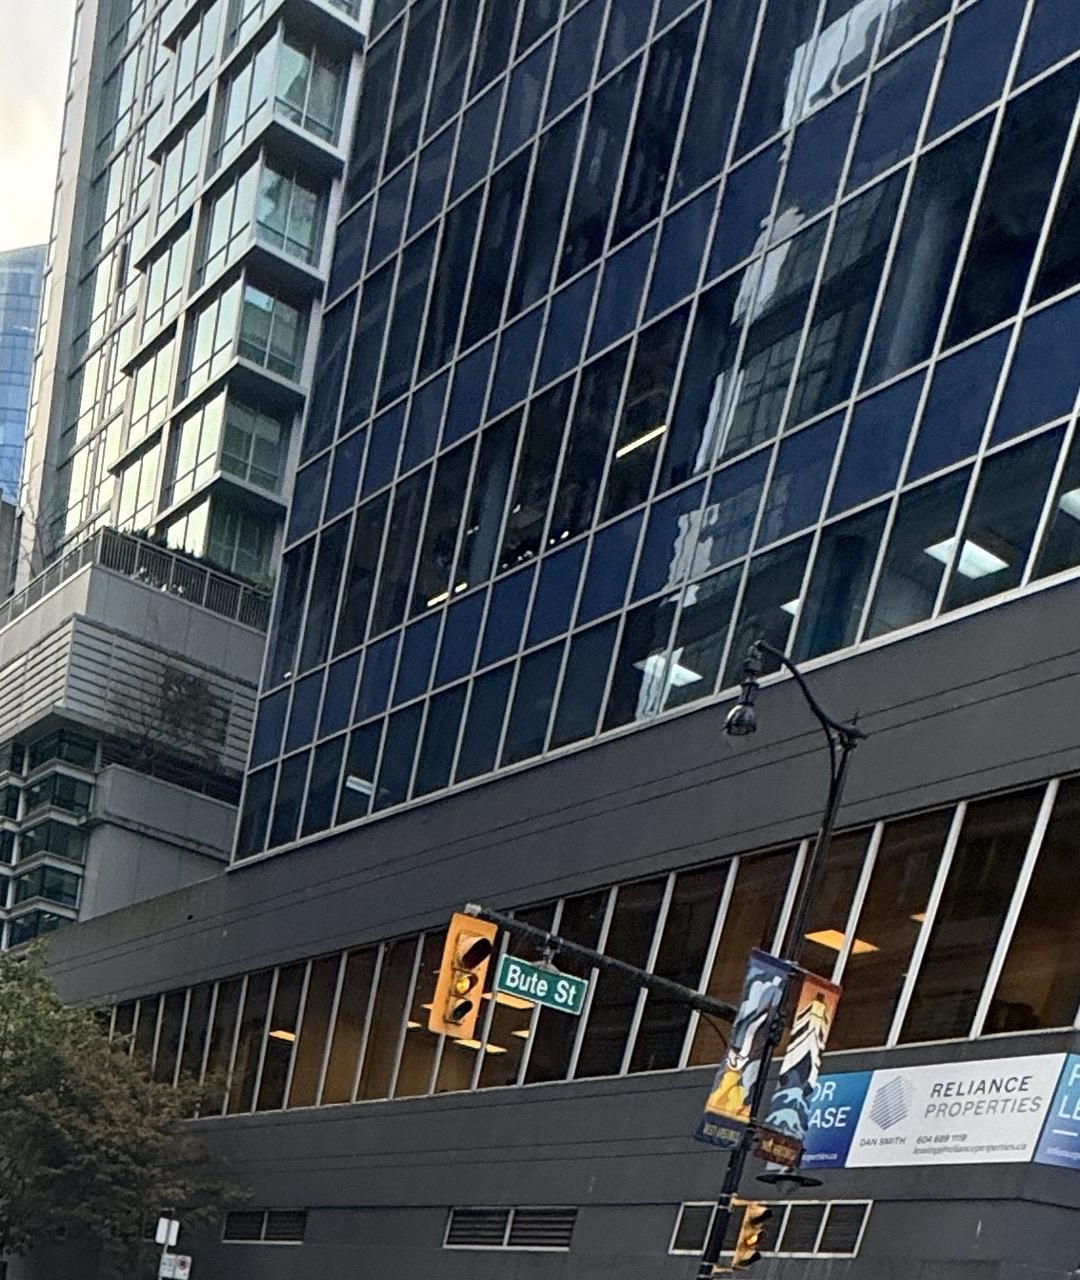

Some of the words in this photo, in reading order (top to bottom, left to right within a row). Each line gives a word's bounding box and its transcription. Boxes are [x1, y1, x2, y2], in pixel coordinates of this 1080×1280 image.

[505, 964, 548, 997] Bute
[554, 980, 576, 1006] St
[810, 1081, 836, 1102] OR
[930, 1075, 1034, 1098] RELIANCE
[808, 1106, 851, 1129] ASE
[924, 1095, 1042, 1119] PROPERTIES
[860, 1138, 877, 1147] DAN
[879, 1136, 907, 1146] SMITH
